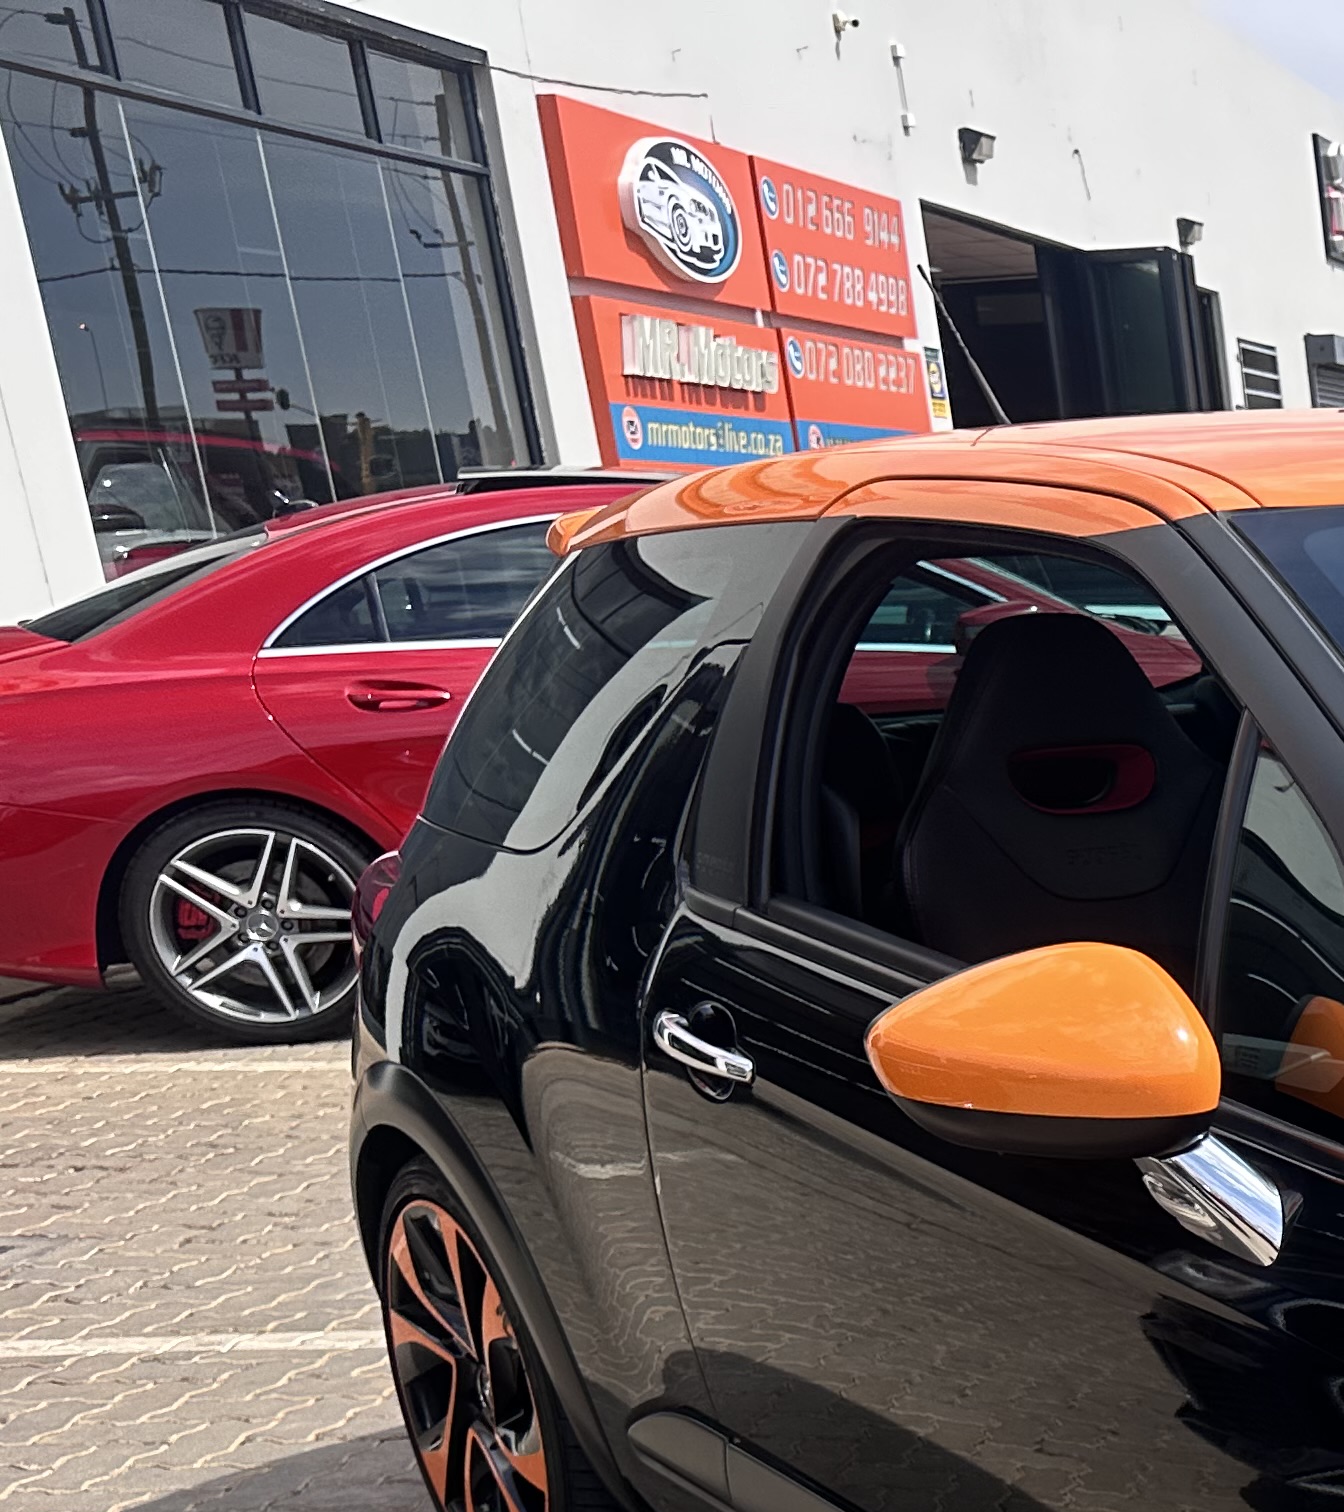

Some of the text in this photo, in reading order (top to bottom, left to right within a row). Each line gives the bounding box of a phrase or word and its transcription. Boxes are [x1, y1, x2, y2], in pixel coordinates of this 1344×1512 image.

[782, 183, 900, 252] 012 666 9144
[793, 253, 908, 316] 072 788 4998
[679, 323, 779, 394] Motors
[804, 339, 916, 395] 072 080 2237
